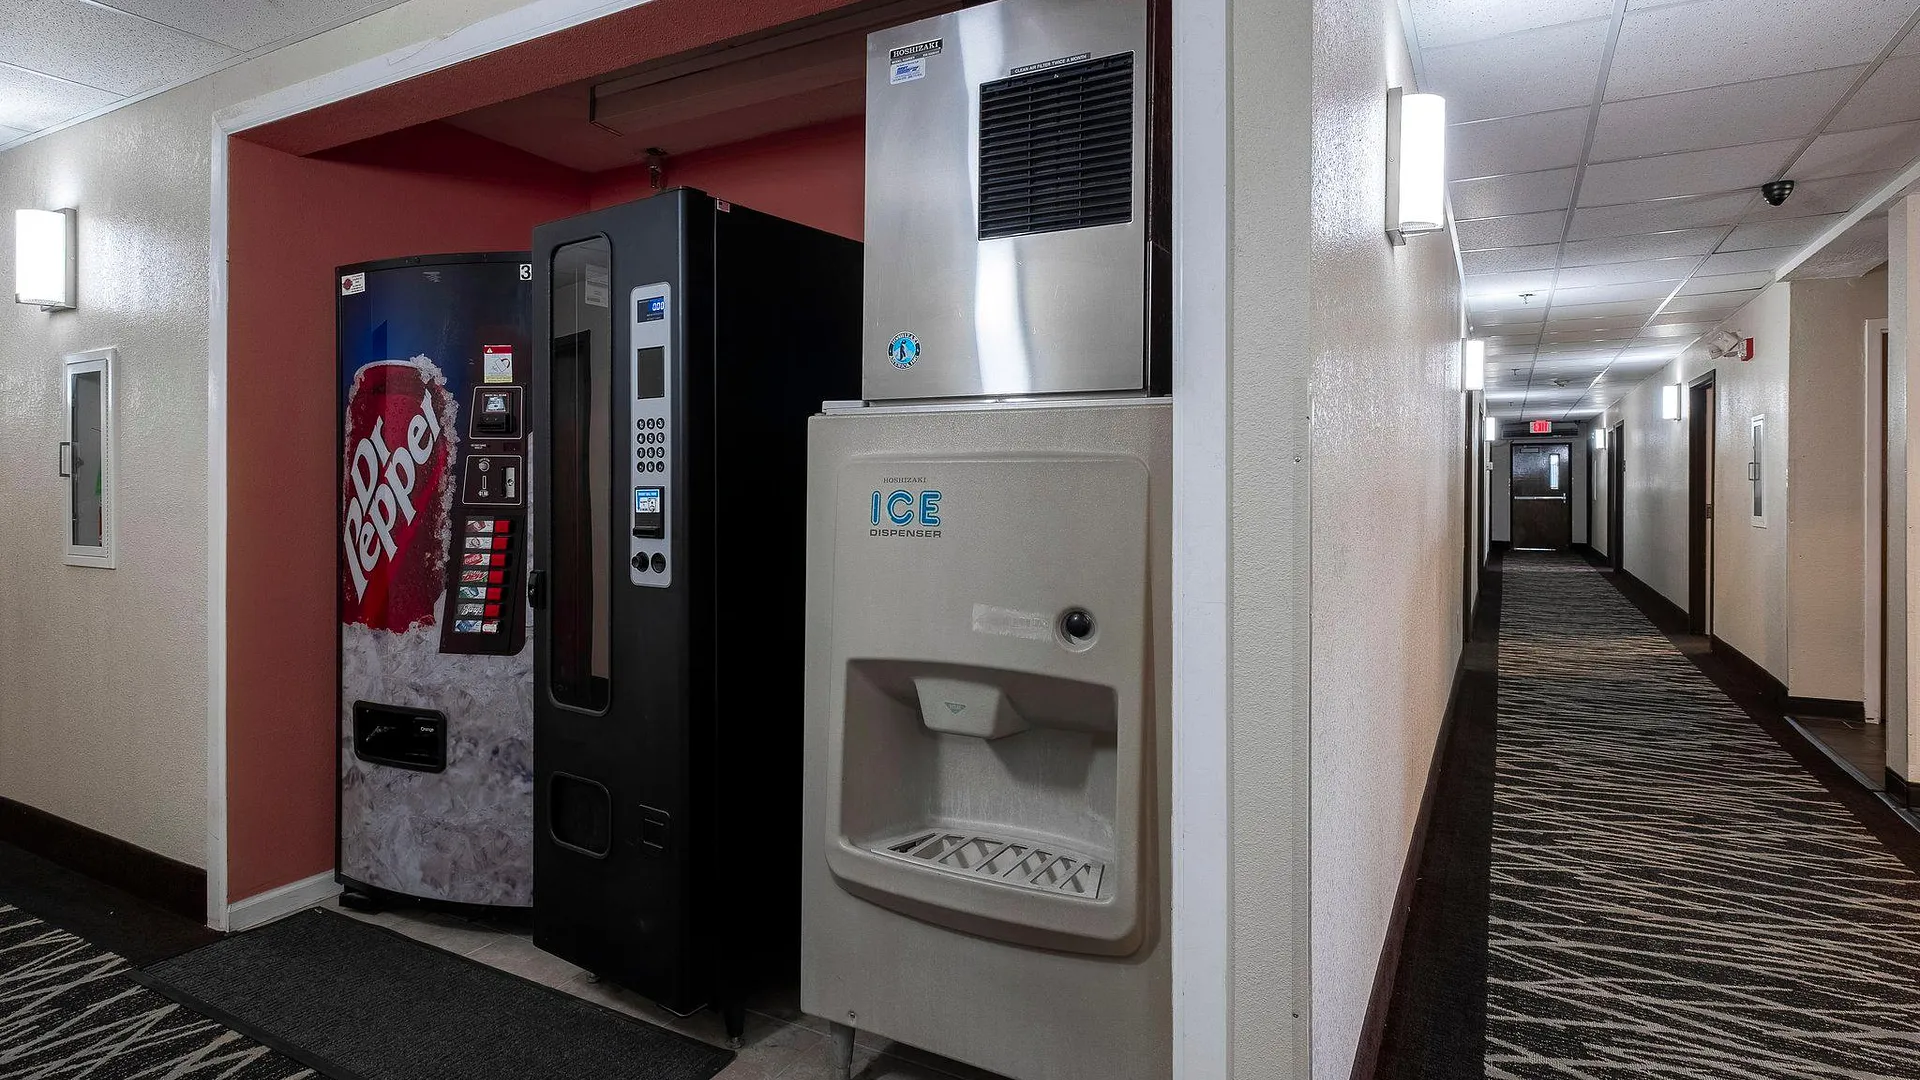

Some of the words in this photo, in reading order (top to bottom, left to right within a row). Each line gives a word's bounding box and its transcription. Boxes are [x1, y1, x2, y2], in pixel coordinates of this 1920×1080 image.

[893, 41, 939, 57] HOSHIZAKI
[1014, 66, 1029, 74] CLEAN
[1037, 61, 1051, 69] FILTER
[1070, 54, 1087, 62] MONTH
[521, 265, 531, 279] 3
[351, 415, 391, 516] Dr
[343, 388, 441, 605] Pepper
[871, 490, 942, 526] ICE
[870, 529, 942, 538] DISPENSER
